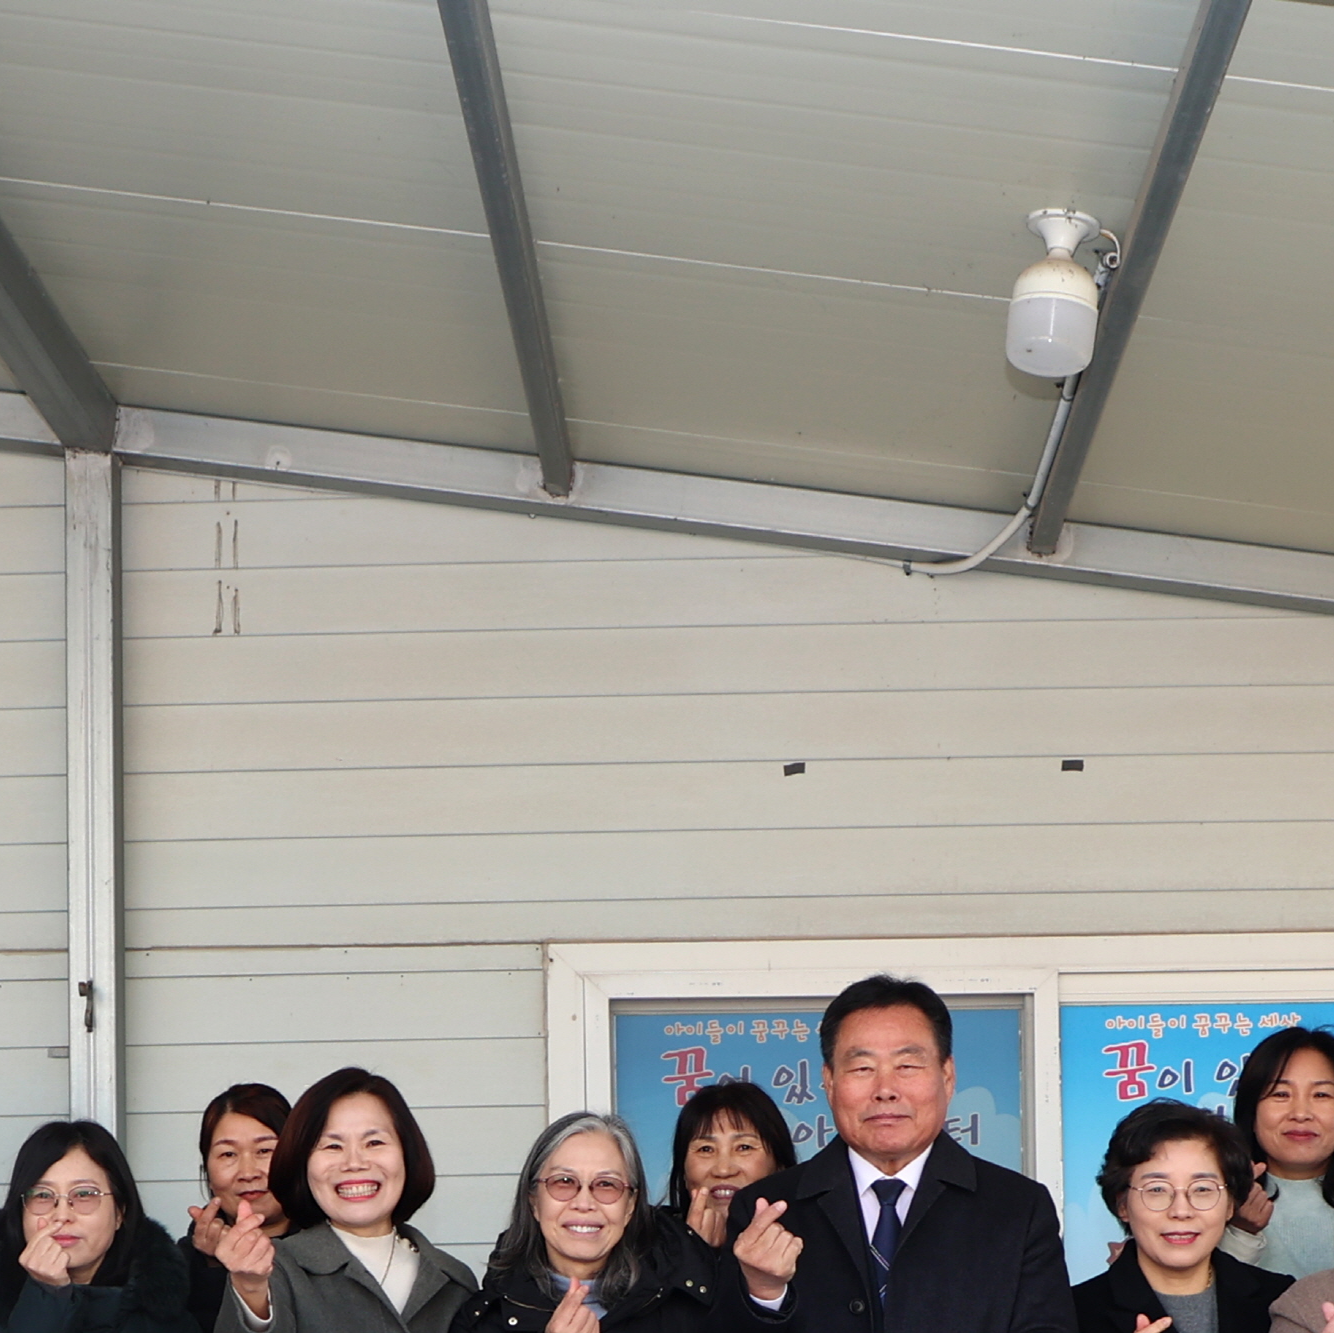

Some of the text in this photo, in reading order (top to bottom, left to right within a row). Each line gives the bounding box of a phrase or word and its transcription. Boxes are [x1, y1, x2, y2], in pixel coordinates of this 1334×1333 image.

[664, 1018, 811, 1045] 아이들이 꿈꾸는
[1105, 1014, 1187, 1038] 아이들이
[1192, 1013, 1253, 1037] 꿈꾸는
[771, 1058, 825, 1105] 있
[1102, 1040, 1194, 1101] 꿈이
